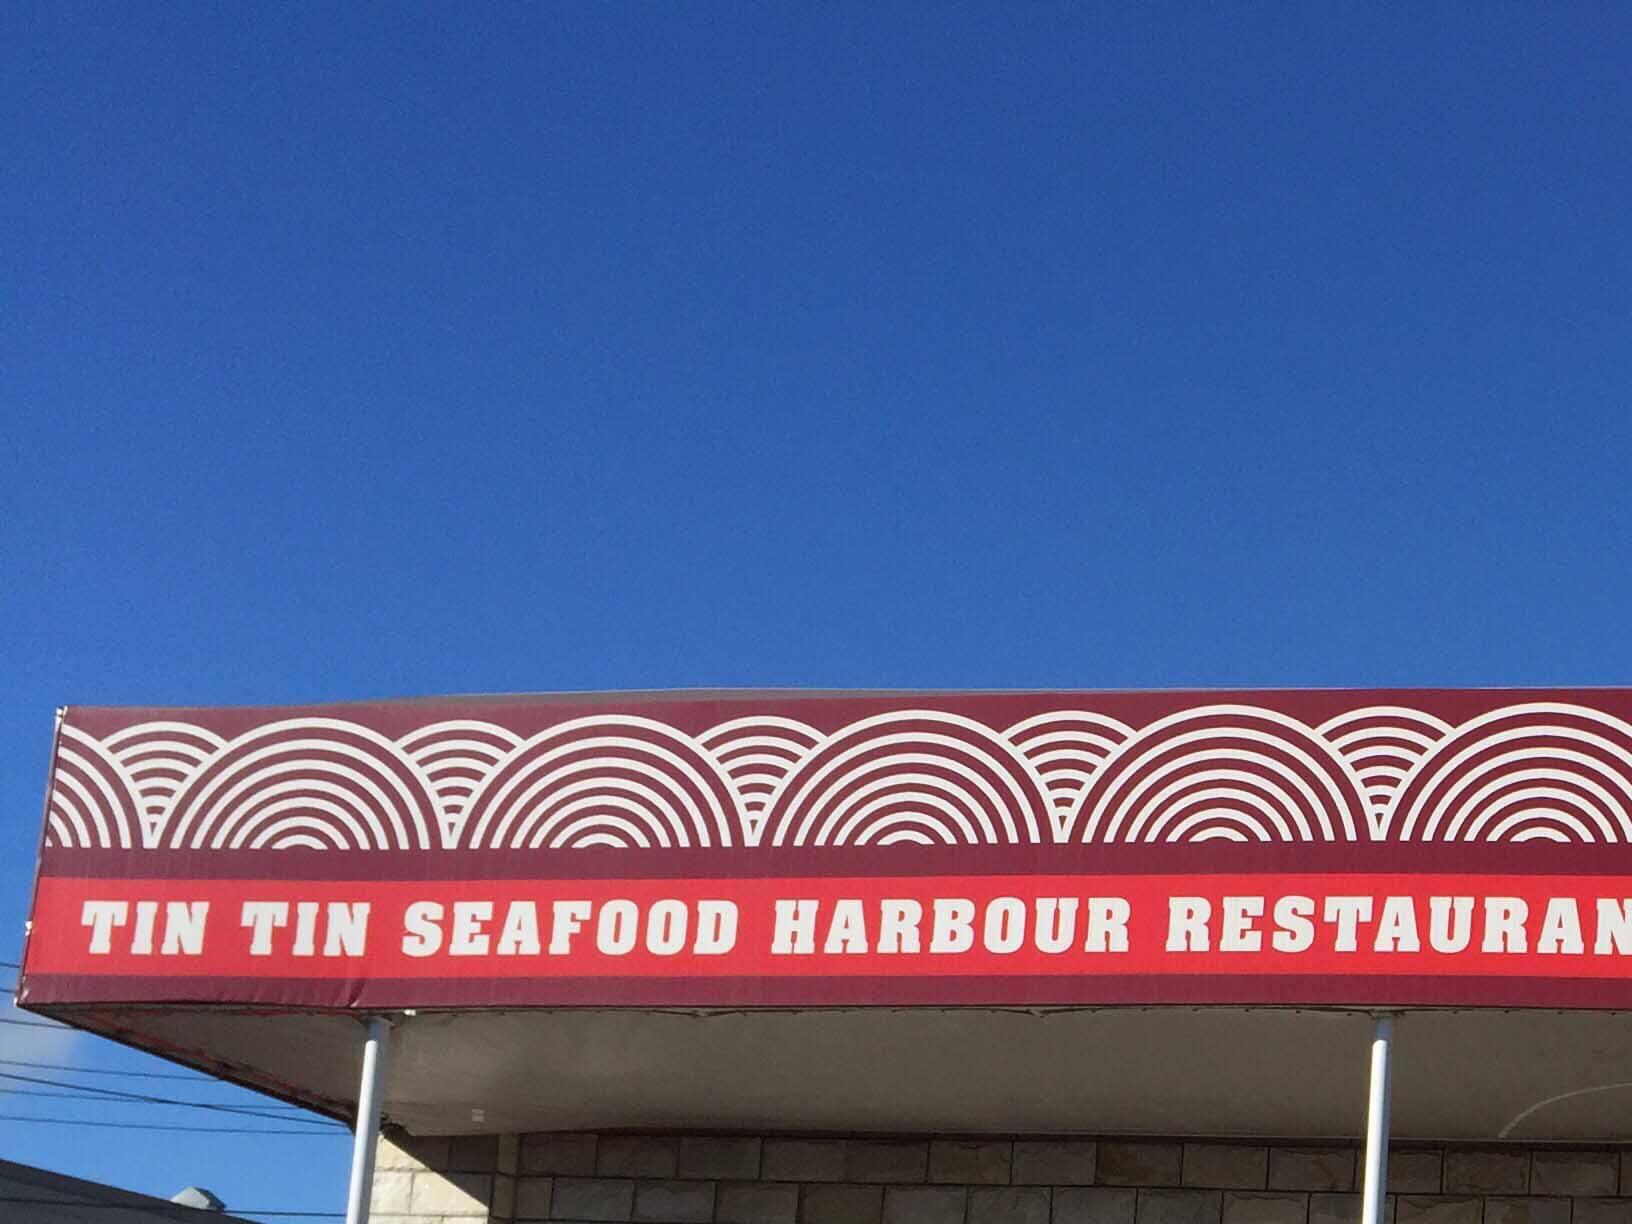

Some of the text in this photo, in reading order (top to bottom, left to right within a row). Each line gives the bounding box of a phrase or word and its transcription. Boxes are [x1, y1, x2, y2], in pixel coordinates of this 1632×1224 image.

[82, 901, 210, 956] TIN
[241, 902, 371, 957] TIN
[402, 900, 739, 958] SEAFOOD
[771, 897, 1132, 956] HARBOUR
